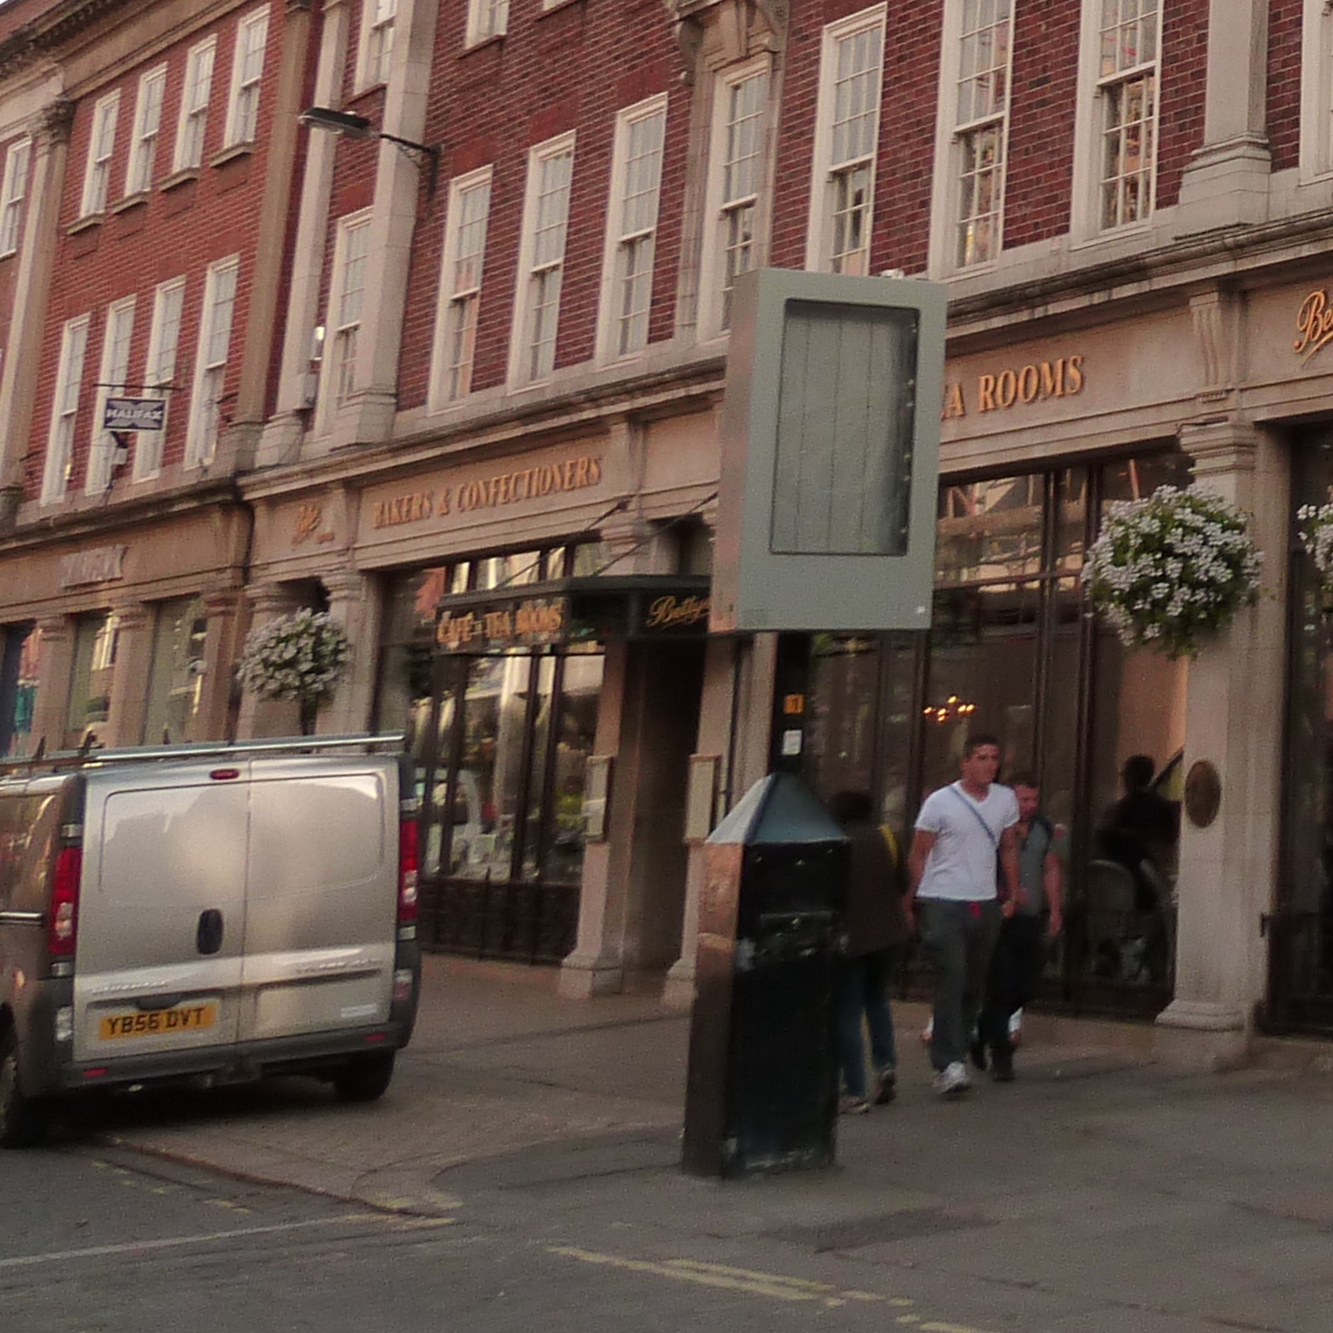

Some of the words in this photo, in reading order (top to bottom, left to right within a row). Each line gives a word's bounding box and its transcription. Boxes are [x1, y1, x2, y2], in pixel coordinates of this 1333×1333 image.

[978, 354, 1083, 413] ROOMS
[106, 408, 163, 420] HALIFAX
[373, 490, 433, 528] BAKERS
[438, 486, 450, 516] &
[455, 457, 602, 513] CONFECTIONERS
[165, 1007, 205, 1028] DVT
